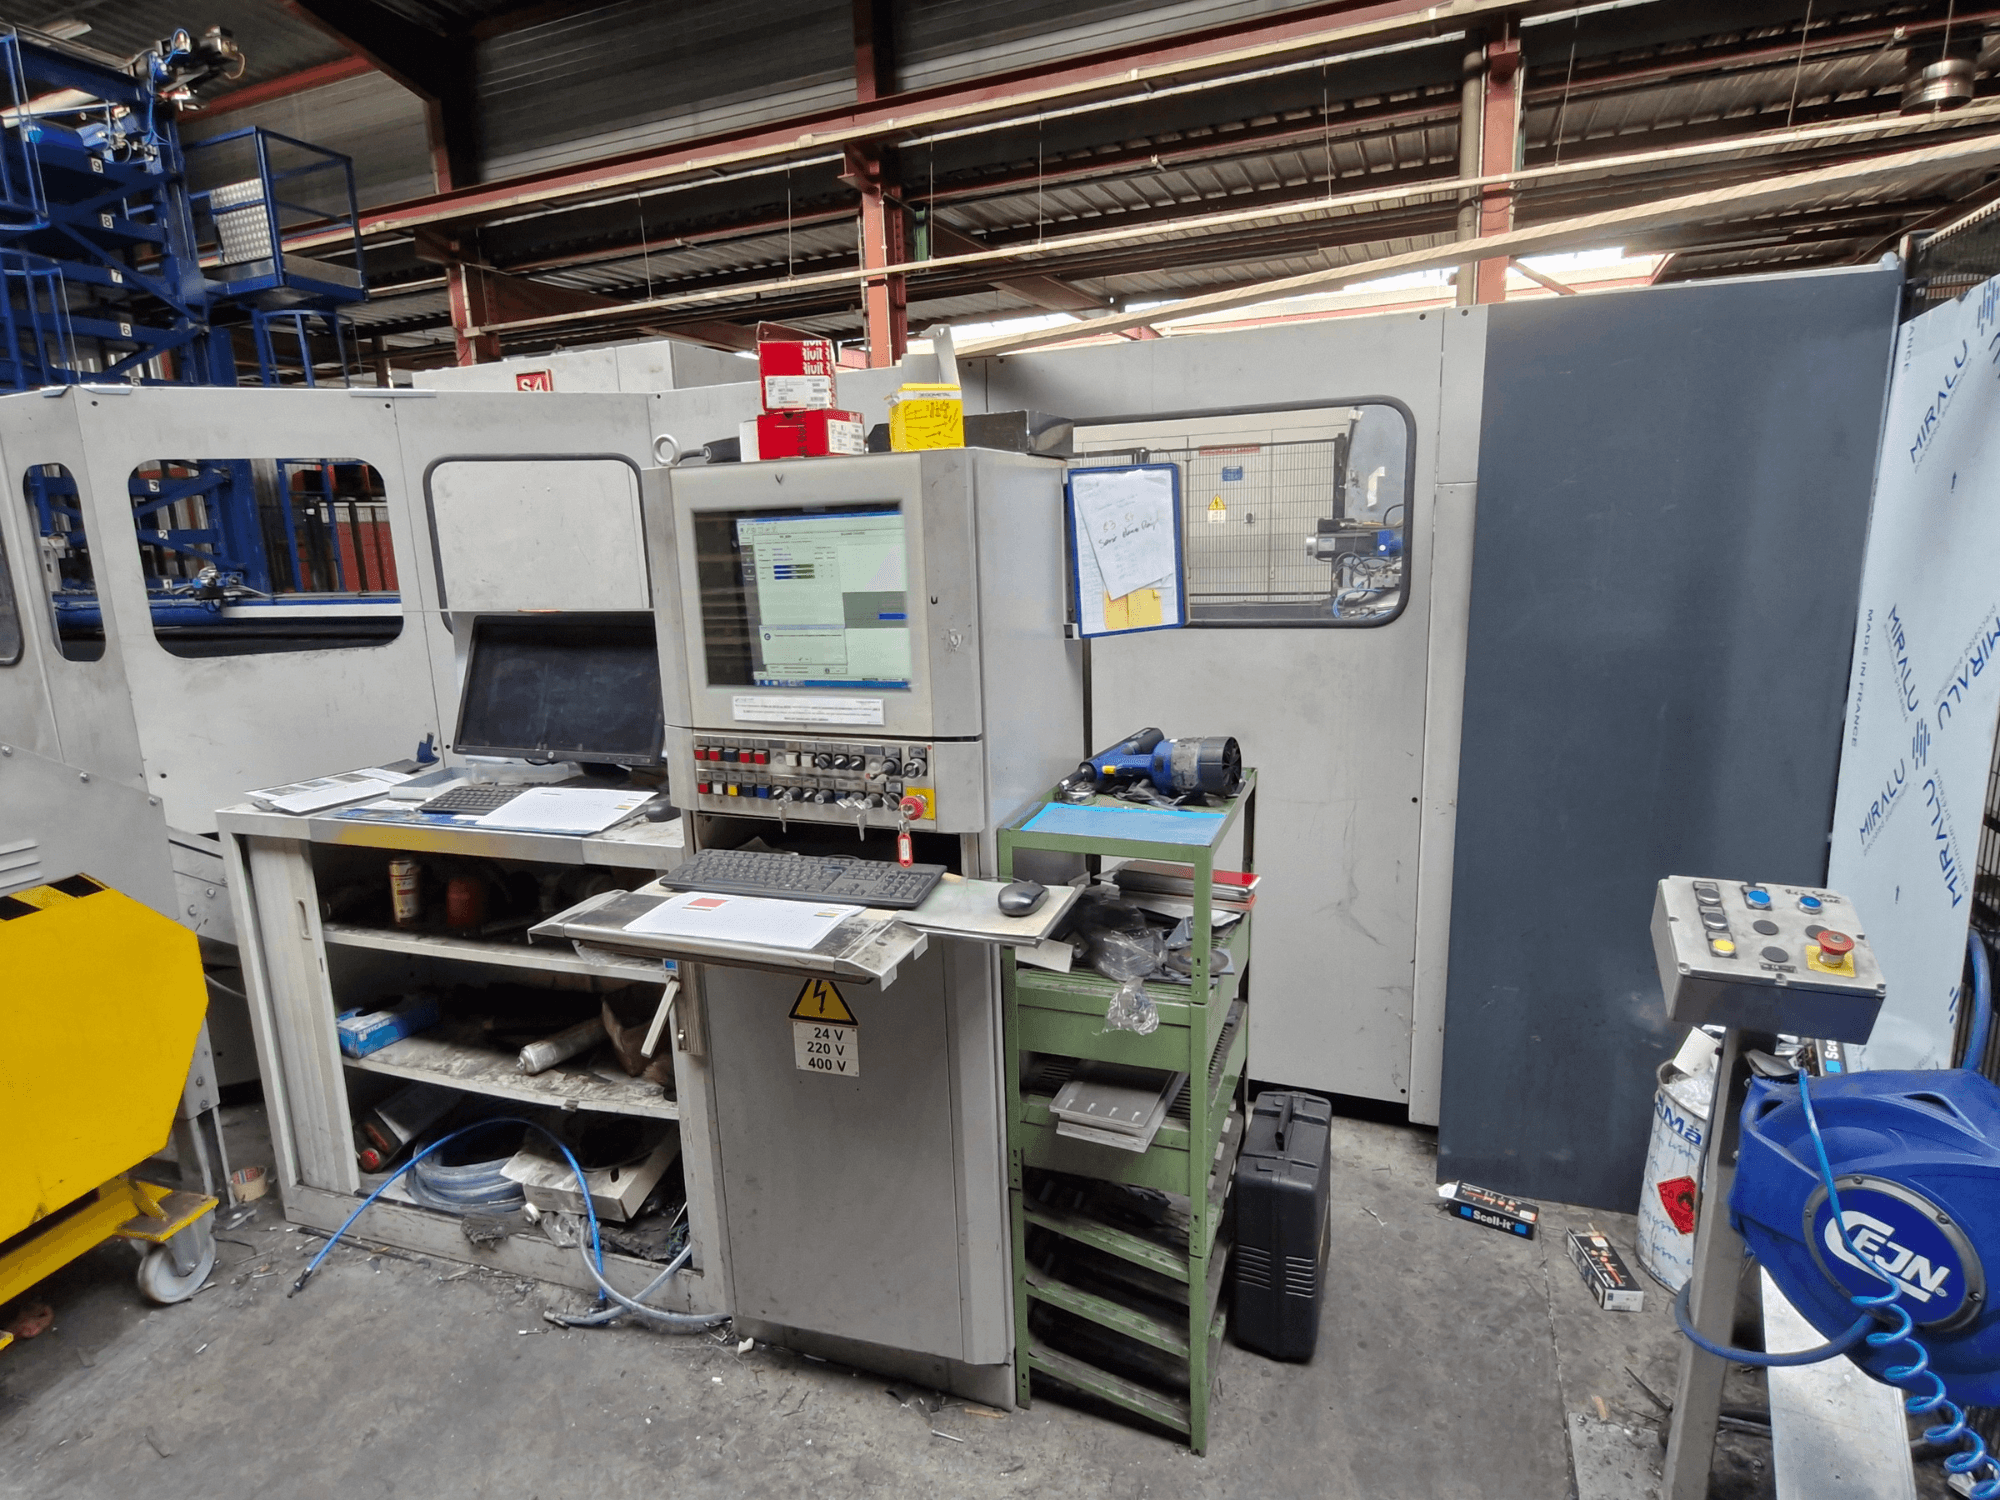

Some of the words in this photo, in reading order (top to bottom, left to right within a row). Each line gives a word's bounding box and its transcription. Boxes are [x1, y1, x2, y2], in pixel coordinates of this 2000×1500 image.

[92, 160, 101, 171] 9
[103, 216, 112, 227] 8
[113, 269, 121, 281] 7
[123, 325, 130, 335] 6
[1910, 339, 1968, 464] MIRALU
[150, 482, 158, 490] 3
[1863, 609, 1874, 656] MADE
[1888, 603, 1919, 712] MIRALU
[1860, 661, 1867, 677] IN
[1851, 682, 1864, 747] FRANCE
[1859, 758, 1906, 845] MIRALU
[1922, 779, 1963, 909] MIRALU
[814, 1027, 830, 1039] 24
[834, 1029, 844, 1041] V
[807, 1041, 831, 1054] 220
[835, 1044, 845, 1056] V
[808, 1057, 832, 1070] 400
[837, 1060, 846, 1072] V
[1473, 1209, 1512, 1230] Scell-it
